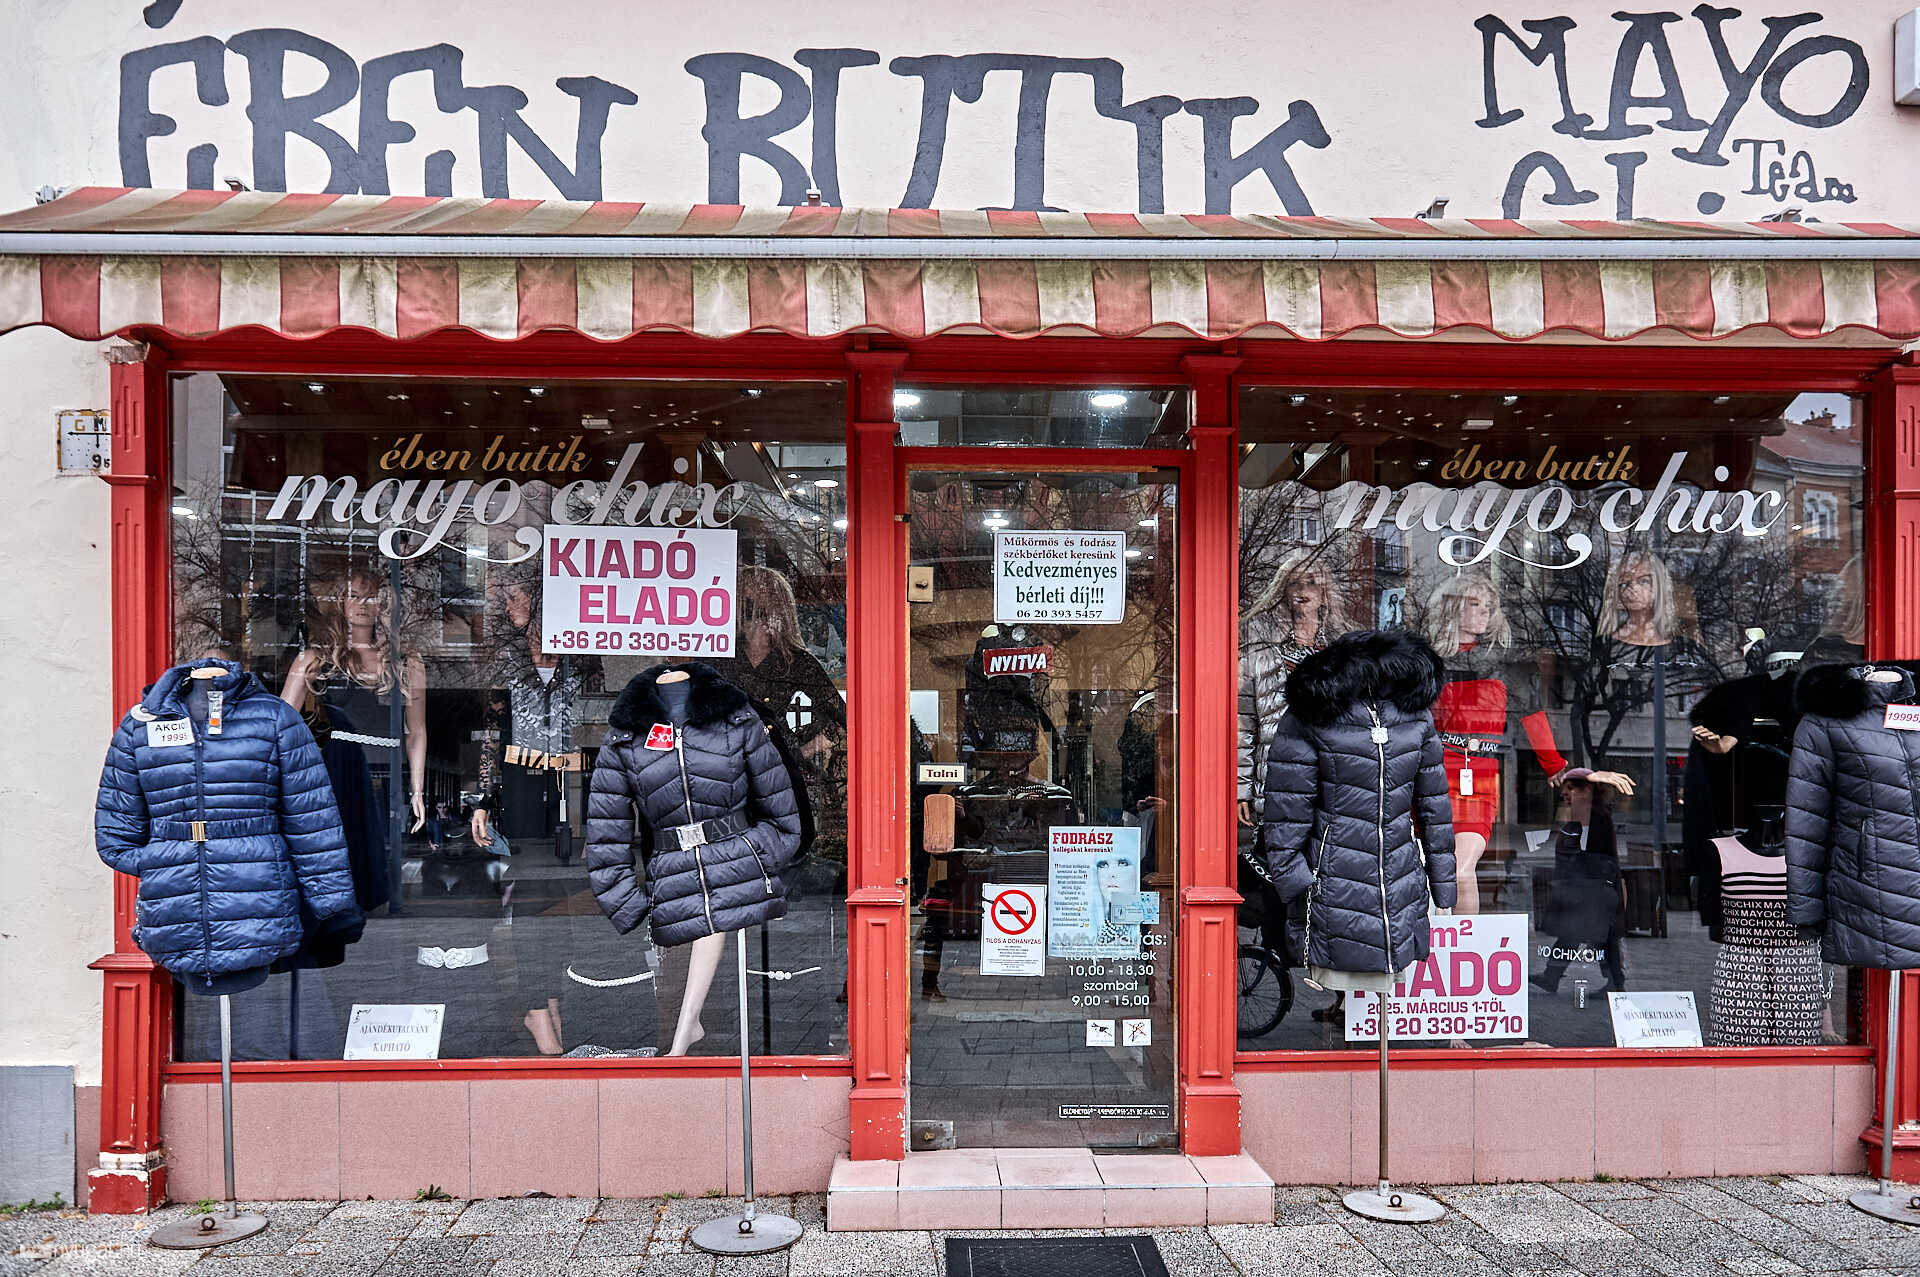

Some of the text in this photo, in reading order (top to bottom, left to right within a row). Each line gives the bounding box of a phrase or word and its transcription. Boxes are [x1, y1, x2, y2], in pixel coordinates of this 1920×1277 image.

[1474, 5, 1869, 166] MAYO
[684, 47, 1331, 217] BUTIK
[1732, 139, 1857, 203] Team
[74, 419, 85, 431] G
[380, 433, 592, 472] ében butik
[1441, 444, 1639, 480] ében butik
[266, 442, 753, 563] mayo chix
[1334, 451, 1789, 569] mayo chix
[1064, 538, 1075, 547] és
[1080, 538, 1117, 547] fodrász
[550, 530, 696, 580] KIADÓ
[1070, 550, 1116, 559] keresünk
[1003, 560, 1117, 584] Kedvezményes
[579, 576, 731, 626] ELADÓ
[1016, 585, 1104, 609] bérleti díj!!!
[1017, 610, 1103, 618] 06 20 393 5457
[550, 631, 729, 652] +36 20 330-5710
[990, 653, 1047, 673] NYITVA
[1441, 733, 1466, 747] CHIX
[926, 769, 958, 778] Tolni
[1053, 828, 1113, 845] FODRÁSZ
[1354, 937, 1522, 998] ADÓ
[1720, 961, 1774, 974] MAYOCHIX
[1739, 955, 1798, 965] MAYOCHIX
[1069, 965, 1104, 977] 10,00
[1118, 965, 1154, 976] 18,30
[1752, 974, 1811, 982] MAYOCHIX
[1083, 980, 1138, 991] szombat
[1727, 980, 1788, 992] MAYOCHIX
[1072, 995, 1101, 1007] 9,00
[1114, 995, 1149, 1007] 15,00
[1407, 998, 1468, 1014] MÁRCIUS
[1737, 999, 1799, 1010] MAYOCHIX
[1396, 1017, 1421, 1035] 20
[1427, 1015, 1522, 1035] 330-5710
[1725, 1025, 1786, 1036] MAYOCHIX
[1750, 1018, 1812, 1028] MAYOCHIX
